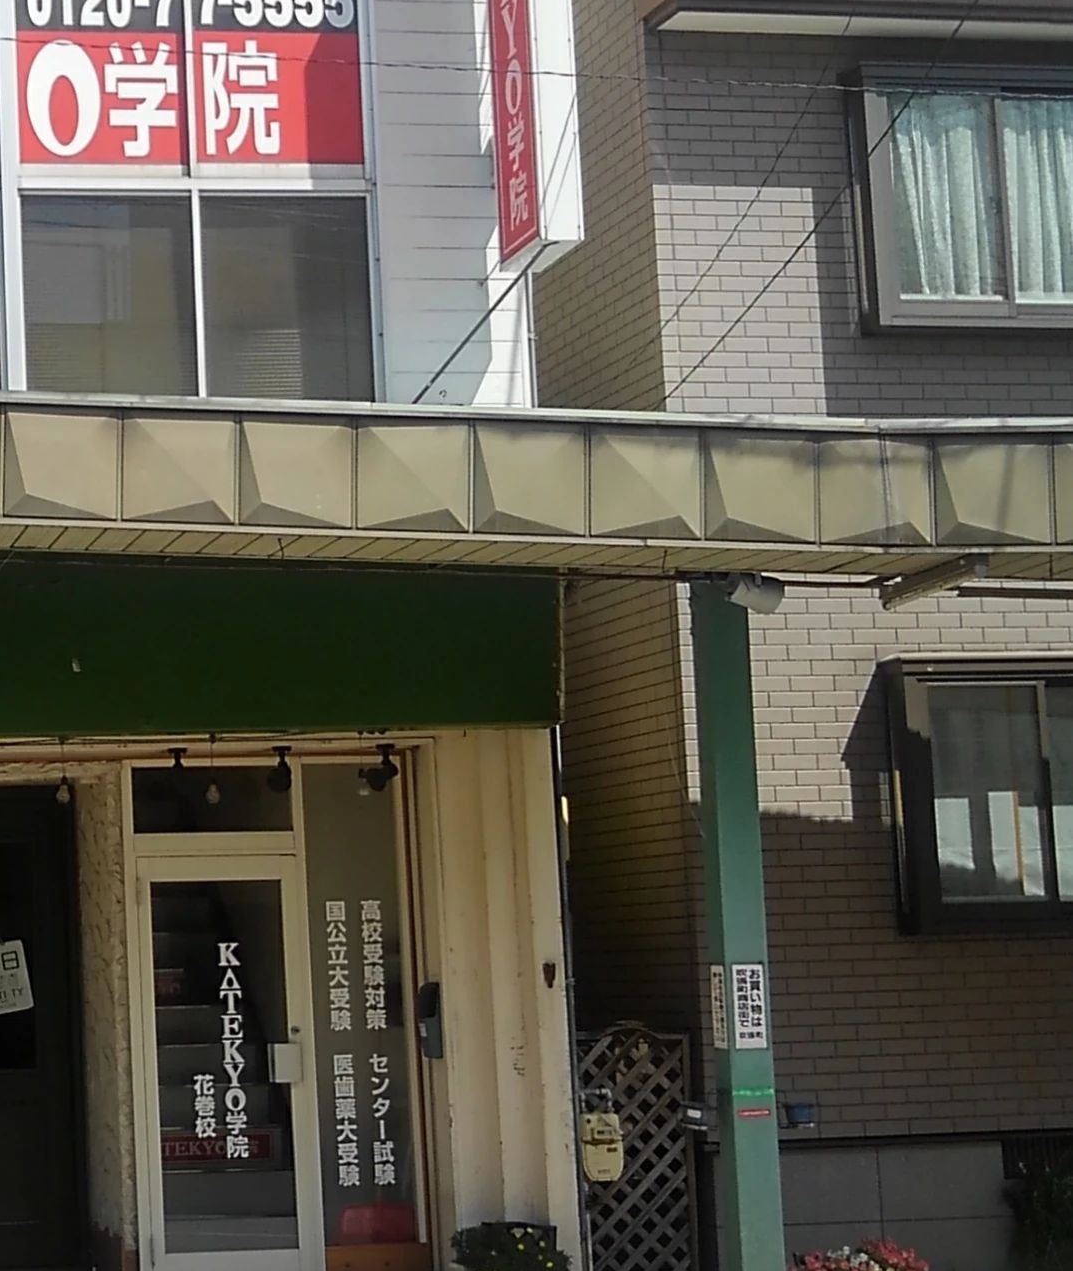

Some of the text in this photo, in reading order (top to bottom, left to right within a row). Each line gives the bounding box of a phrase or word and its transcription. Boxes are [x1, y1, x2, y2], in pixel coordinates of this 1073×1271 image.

[193, 1074, 217, 1138] 花巻校
[217, 942, 249, 1159] KATEKYO学院
[325, 901, 360, 1187] 国公立大受験 医歯薬大受験
[360, 900, 396, 1186] 高校受験対策 センター試験
